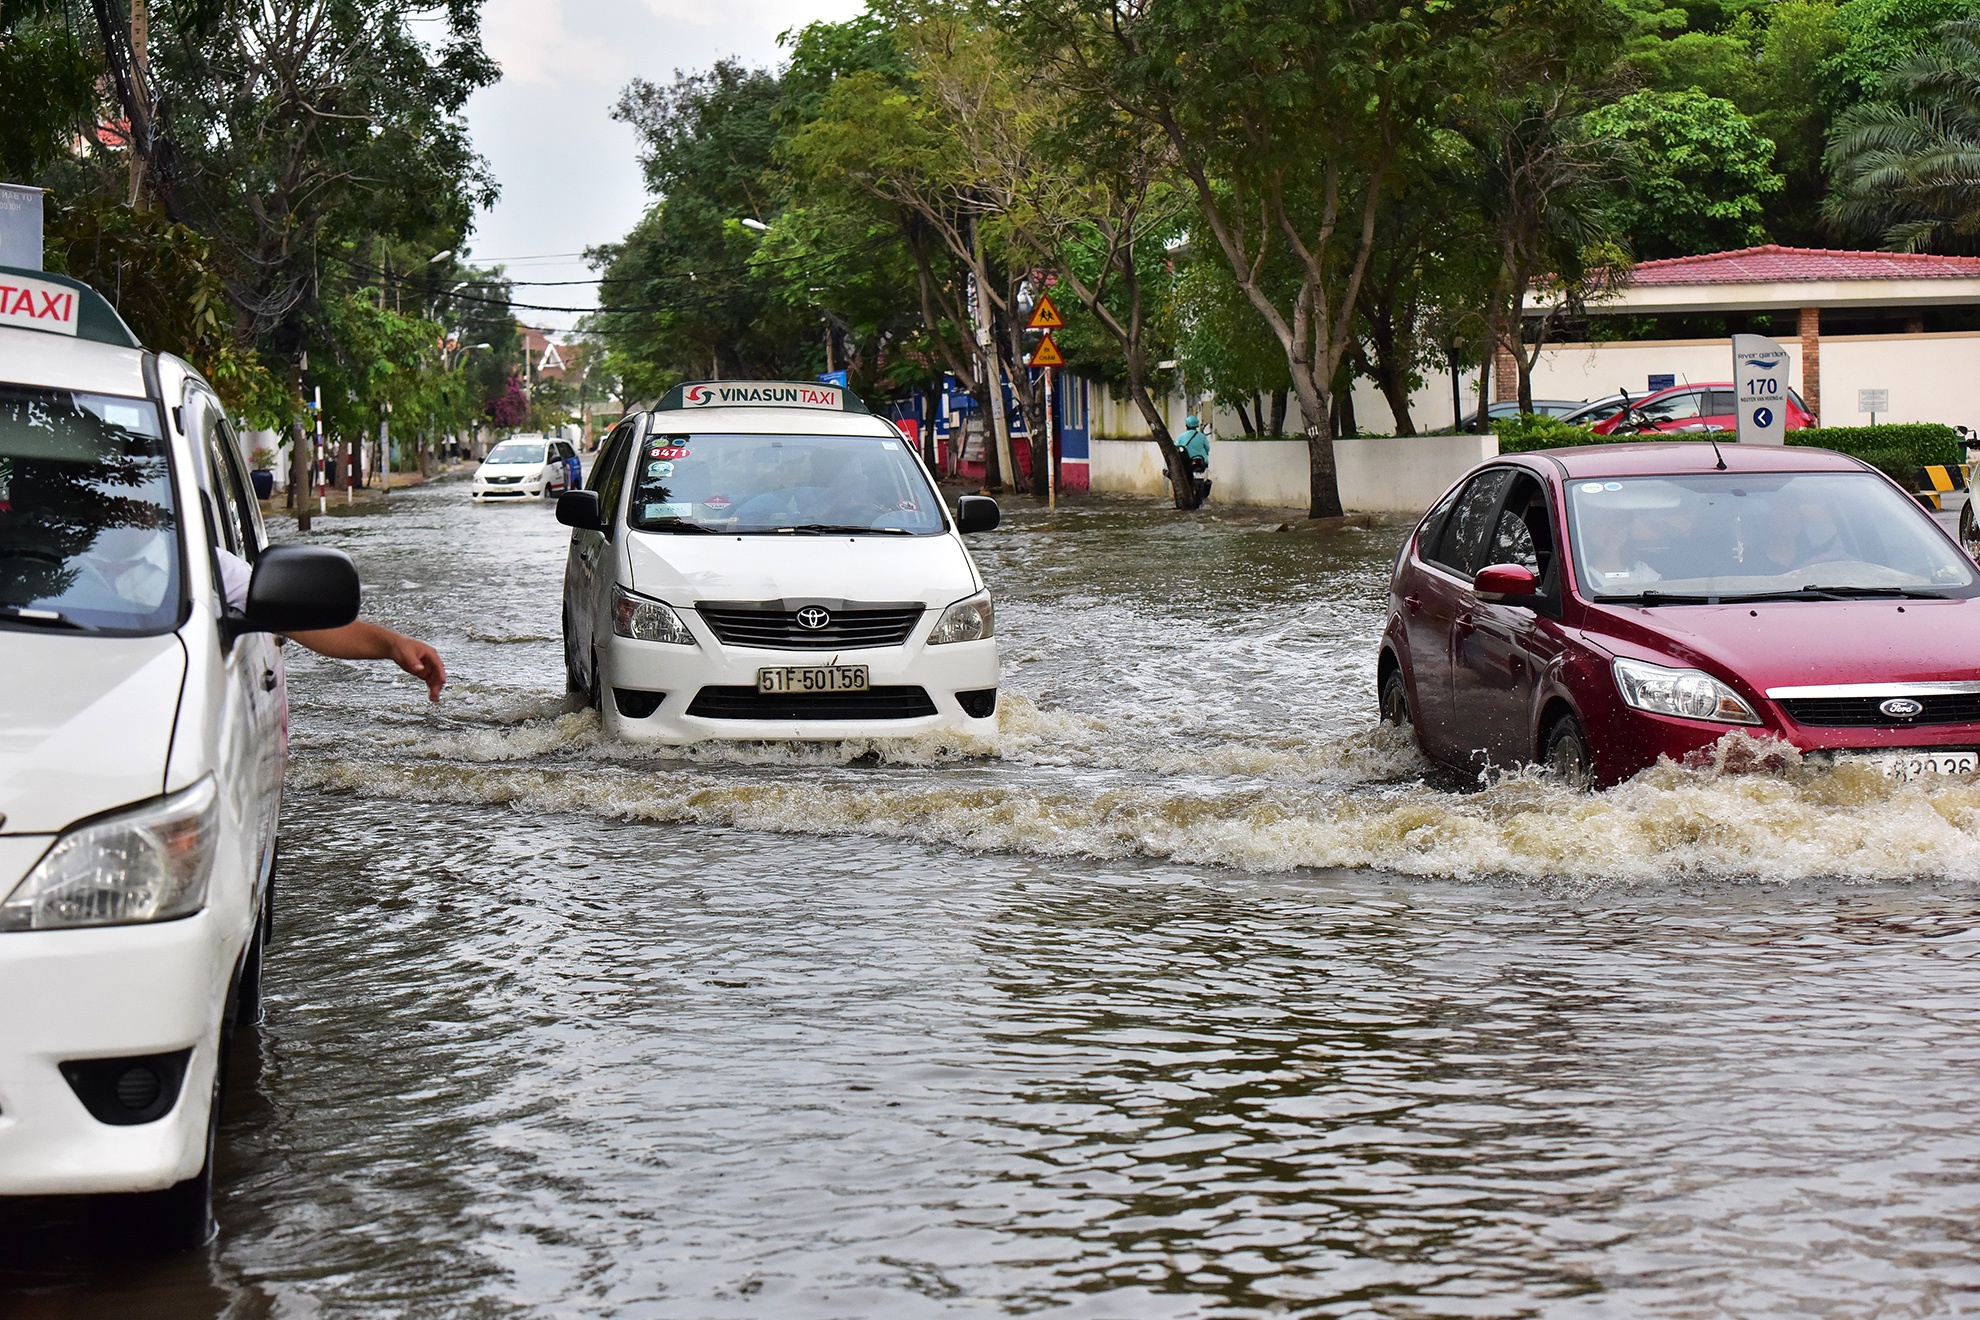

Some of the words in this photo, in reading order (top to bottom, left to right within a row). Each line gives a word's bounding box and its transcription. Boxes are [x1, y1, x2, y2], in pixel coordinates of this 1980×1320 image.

[0, 286, 72, 322] TAXI
[1747, 378, 1778, 395] 170
[719, 388, 798, 402] VINASUN
[800, 389, 835, 406] TAXI
[650, 448, 688, 457] 8471
[762, 668, 865, 691] 51F-501.56
[1889, 702, 1914, 713] Ford
